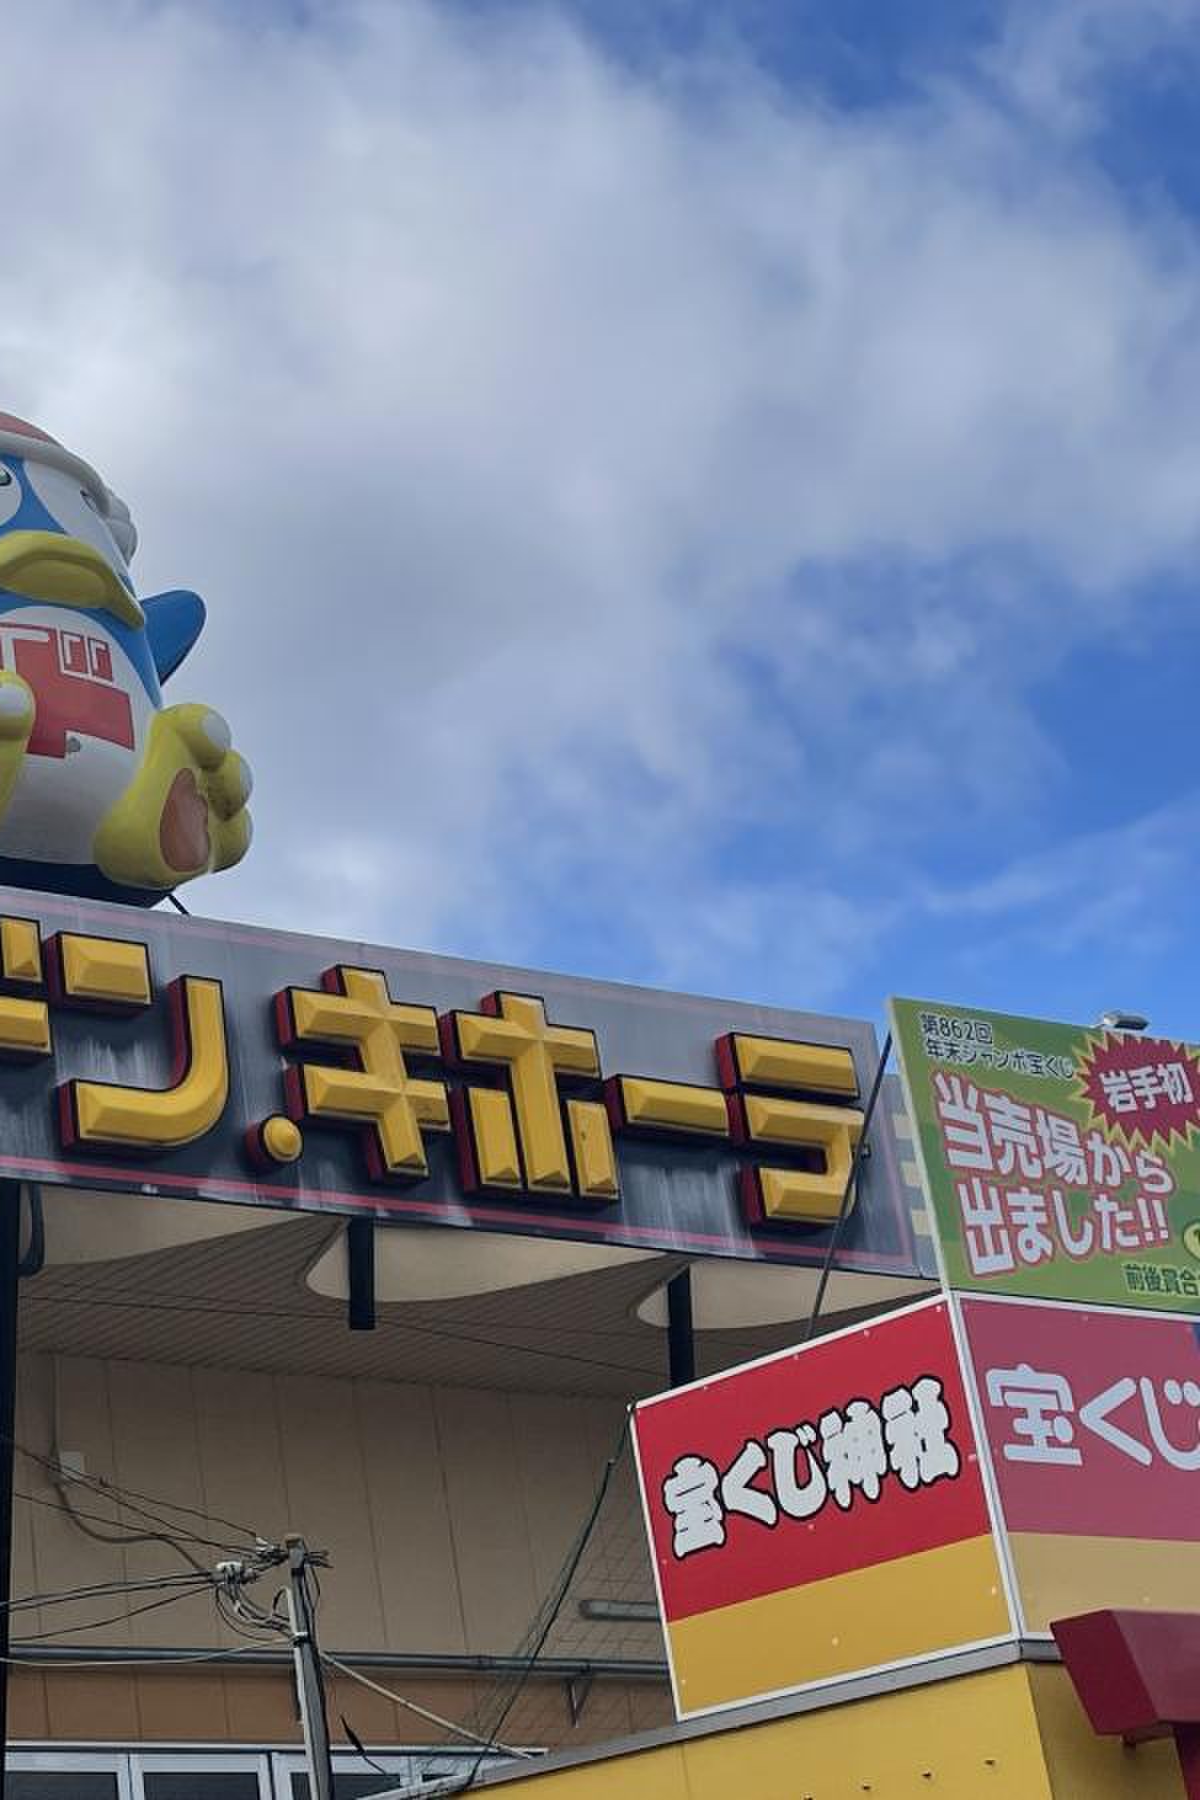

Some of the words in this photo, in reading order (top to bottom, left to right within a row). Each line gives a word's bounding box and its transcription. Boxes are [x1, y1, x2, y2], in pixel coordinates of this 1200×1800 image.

[922, 1013, 993, 1044] 第862回
[926, 1038, 1074, 1080] 年末ジャンボ宝くじ
[1098, 1062, 1195, 1114] 岩手初
[933, 1071, 1175, 1195] 当売場から
[985, 1363, 1200, 1471] 宝くじ
[663, 1374, 960, 1560] 宝くじ神社
